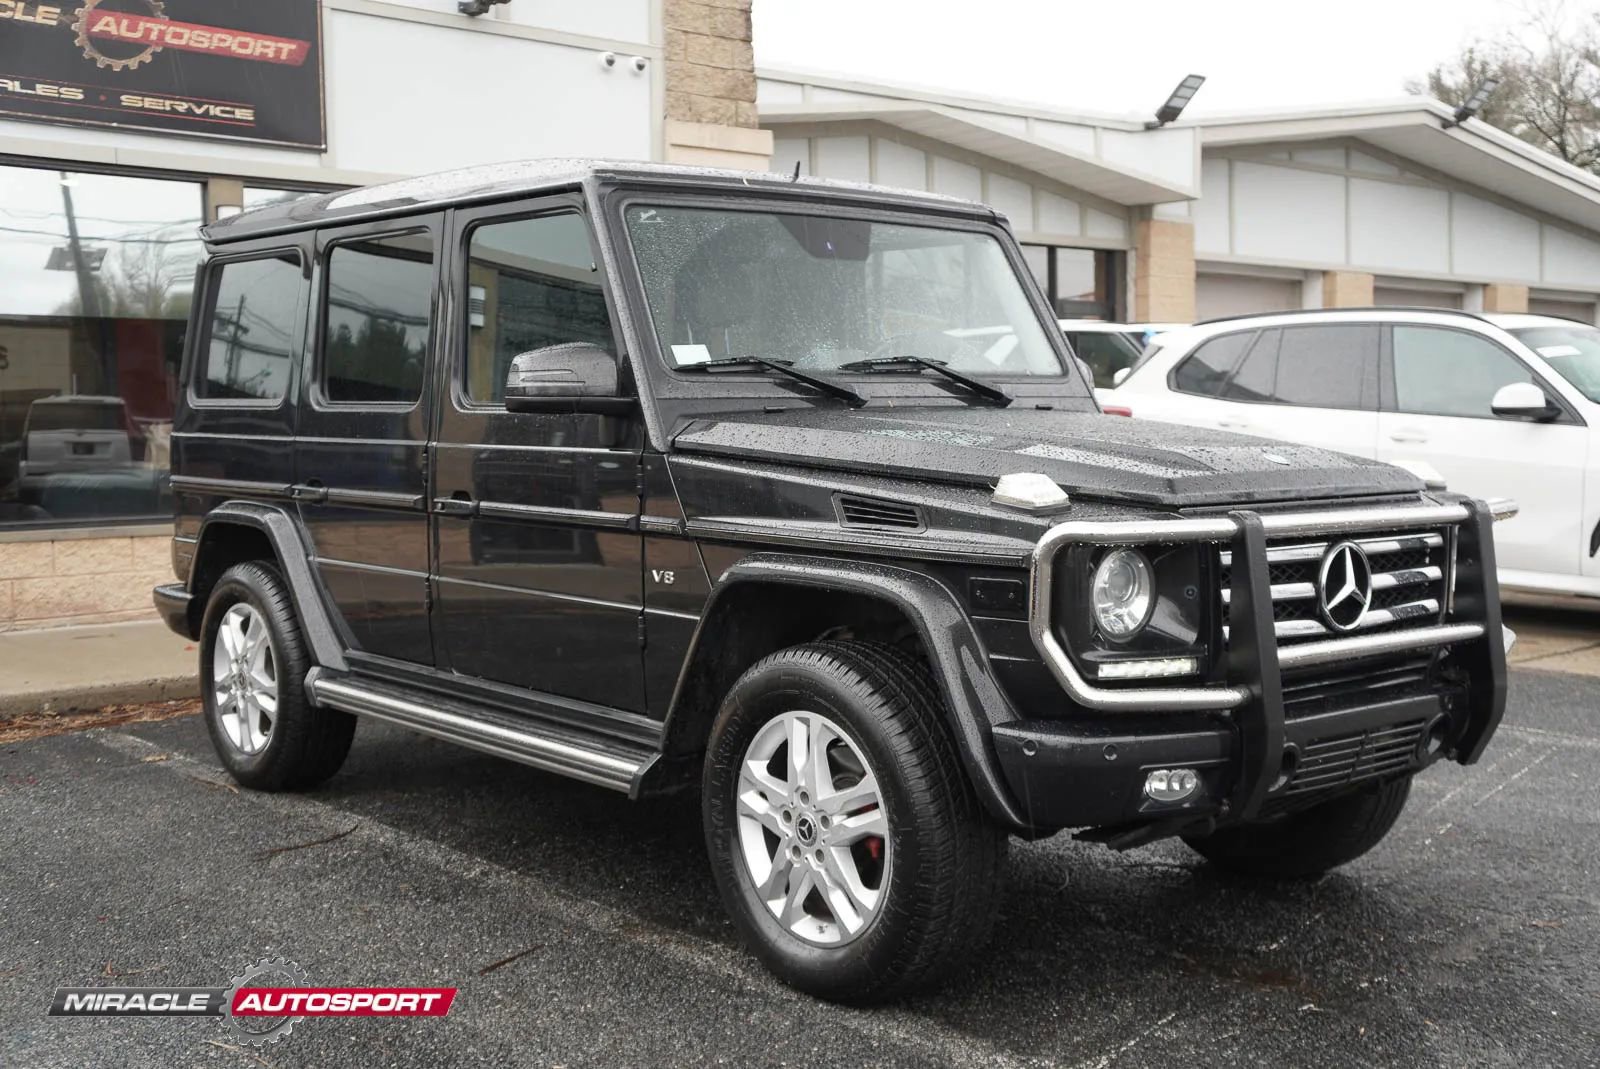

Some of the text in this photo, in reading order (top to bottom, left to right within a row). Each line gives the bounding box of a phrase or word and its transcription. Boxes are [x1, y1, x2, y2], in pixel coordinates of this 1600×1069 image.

[90, 15, 297, 60] AUTOSPORT
[119, 94, 256, 121] SERVICE
[652, 569, 675, 585] V8
